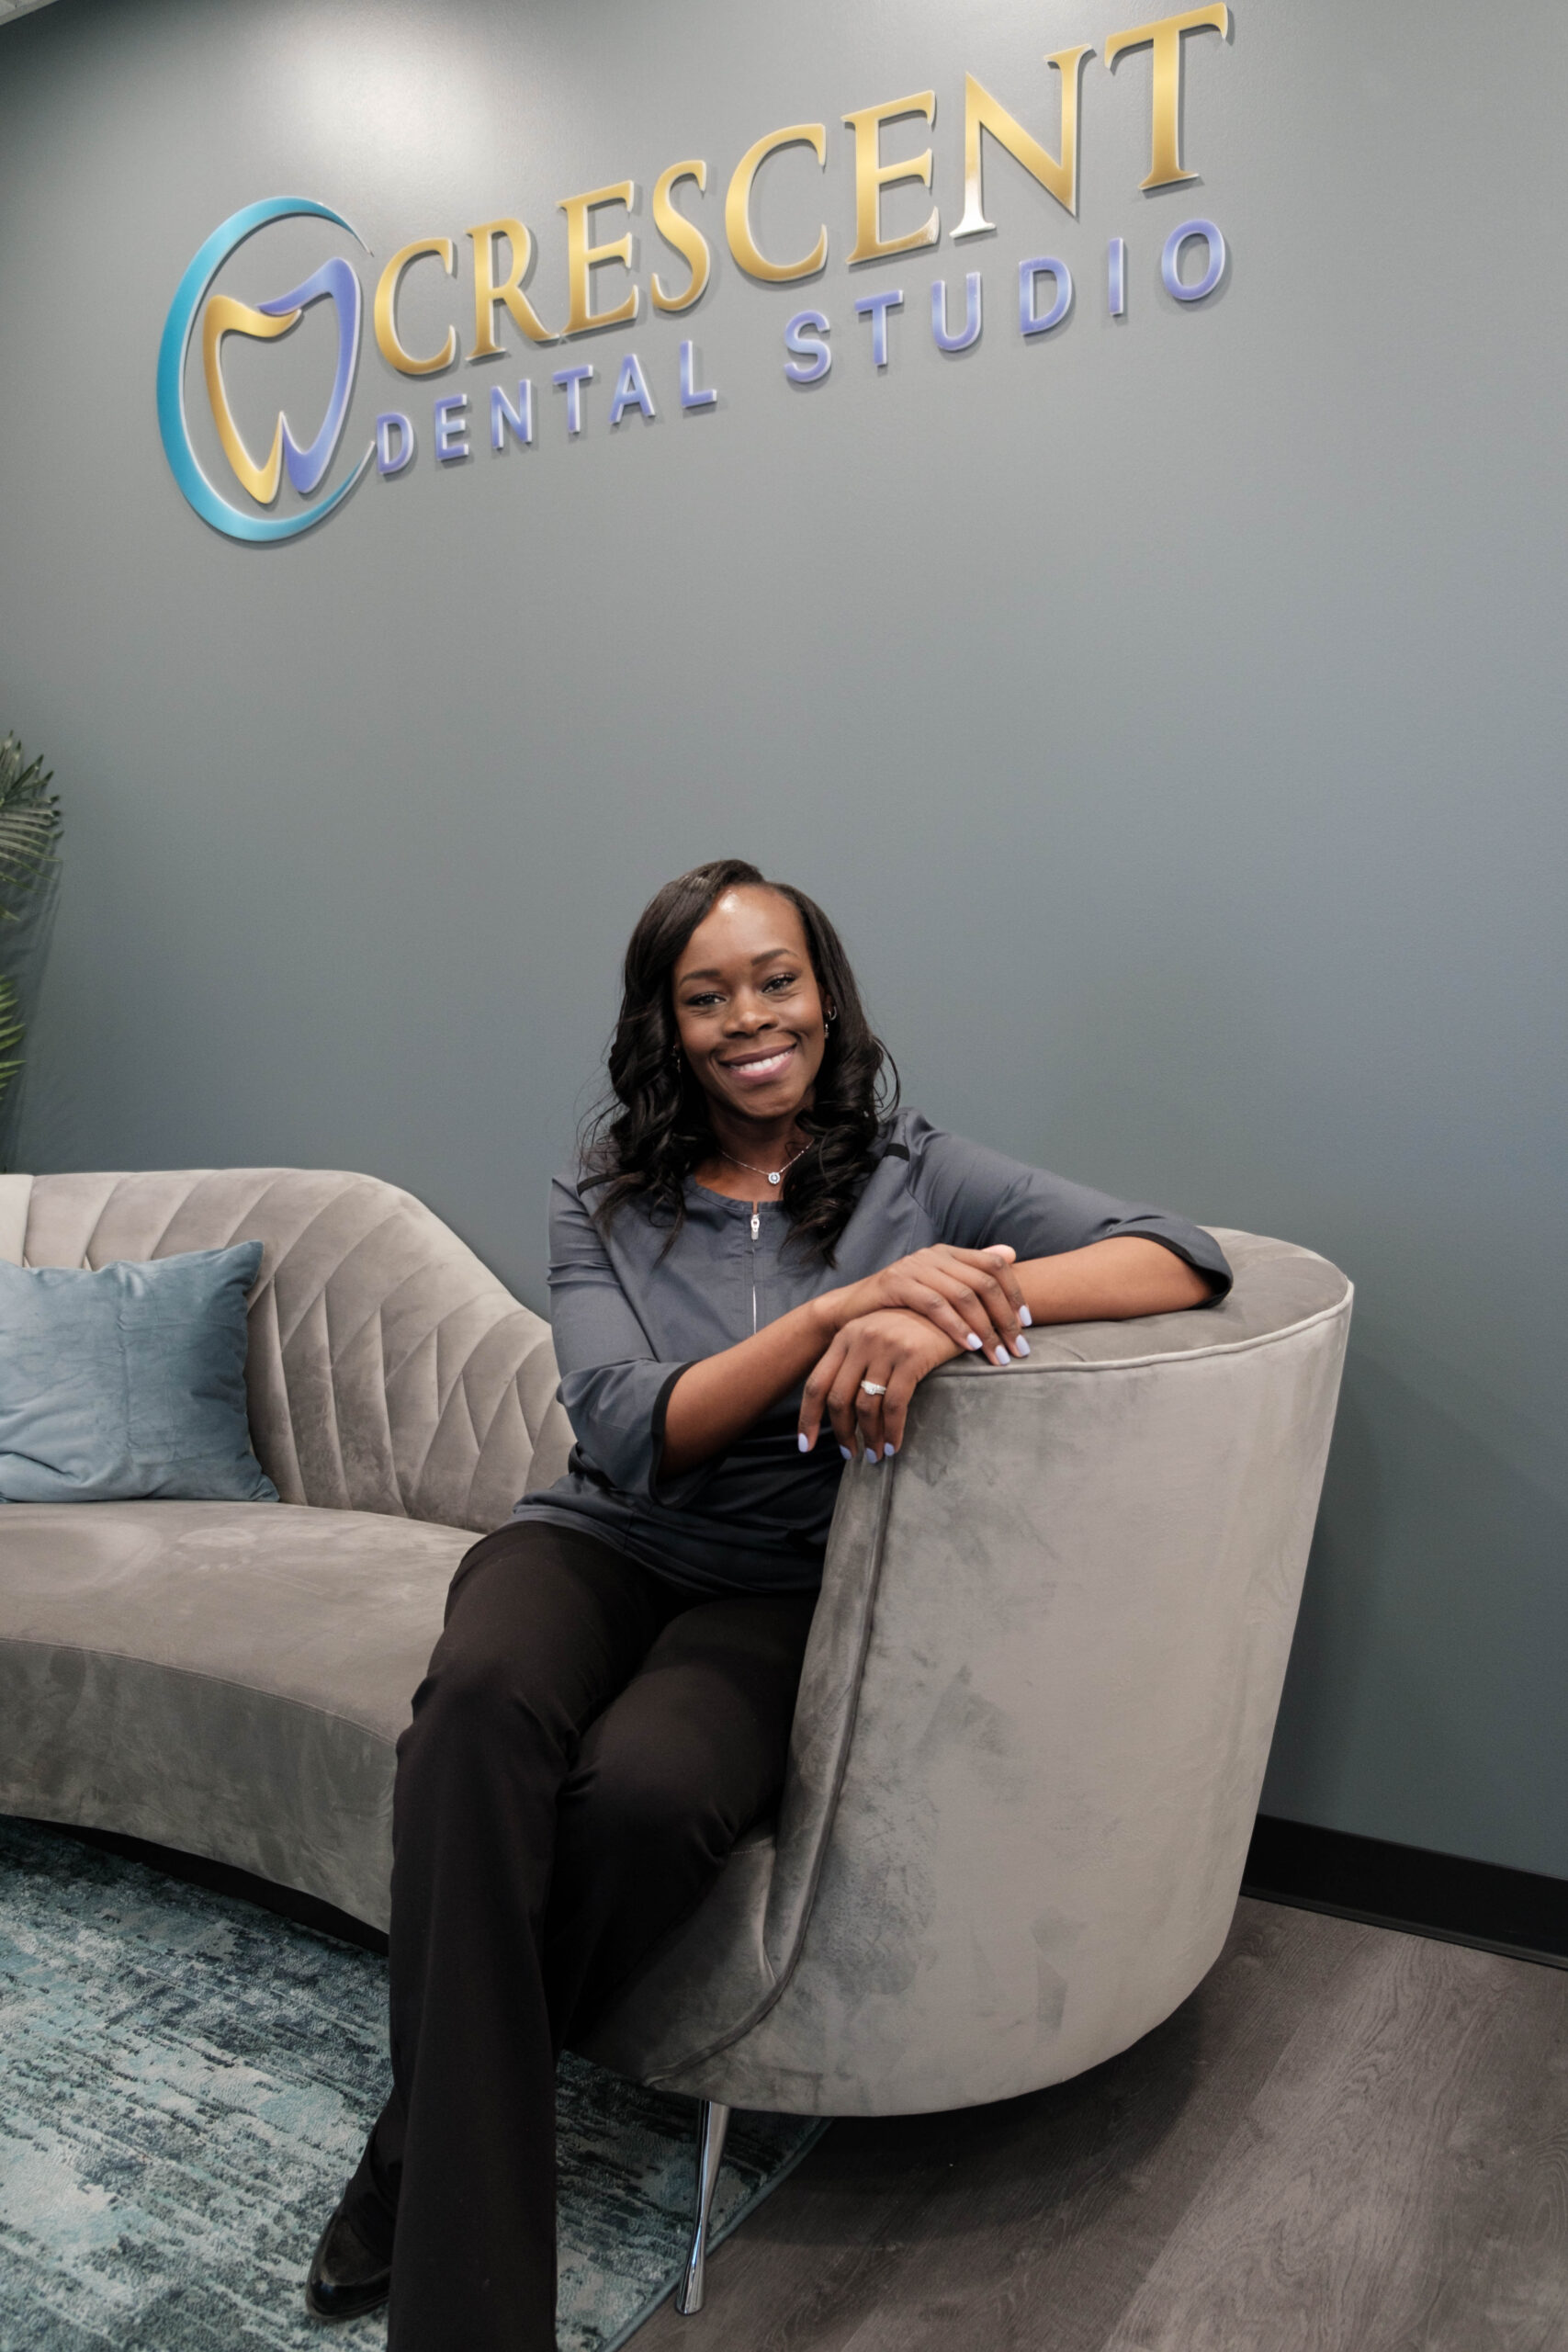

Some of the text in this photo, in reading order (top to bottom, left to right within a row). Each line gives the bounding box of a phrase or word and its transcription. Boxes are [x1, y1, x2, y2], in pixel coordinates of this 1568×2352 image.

[374, 3, 1228, 375] CRESCENT
[377, 220, 1225, 474] DENTAL STUDIO
